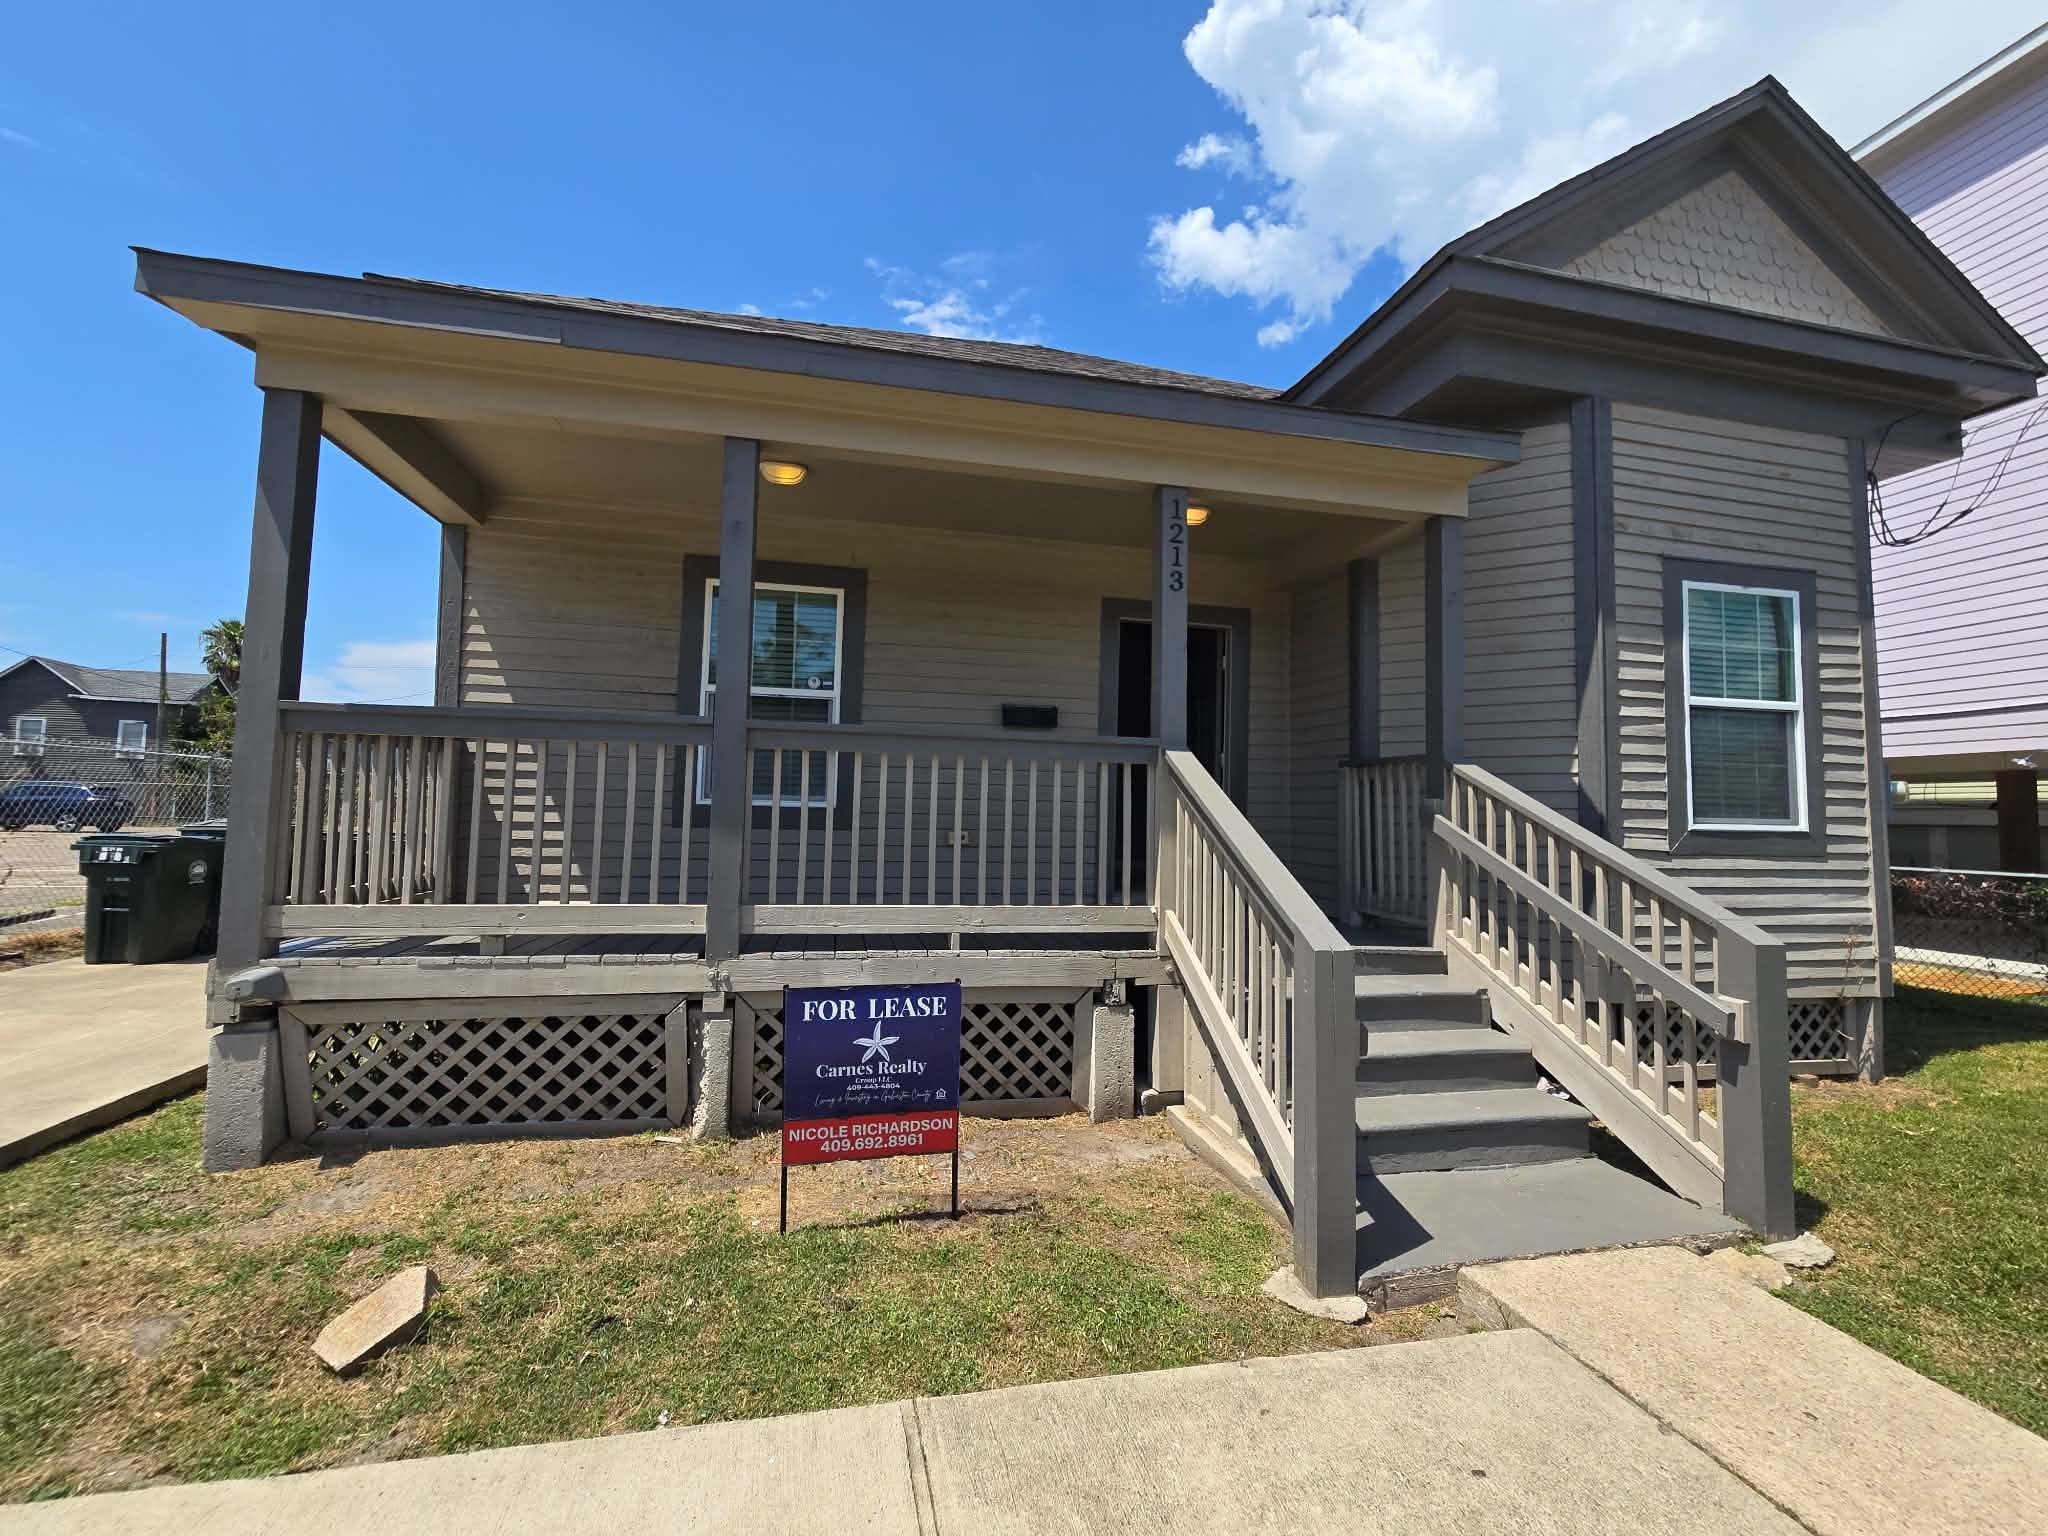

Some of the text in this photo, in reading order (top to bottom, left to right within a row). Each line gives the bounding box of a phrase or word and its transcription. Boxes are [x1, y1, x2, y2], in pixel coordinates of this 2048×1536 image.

[1168, 498, 1184, 592] 1213
[802, 996, 947, 1021] FOR LEASE
[816, 1059, 927, 1079] Carnes Realty
[789, 1118, 953, 1142] NICOLE RICHARDSON
[821, 1133, 923, 1153] 409.692.8961
